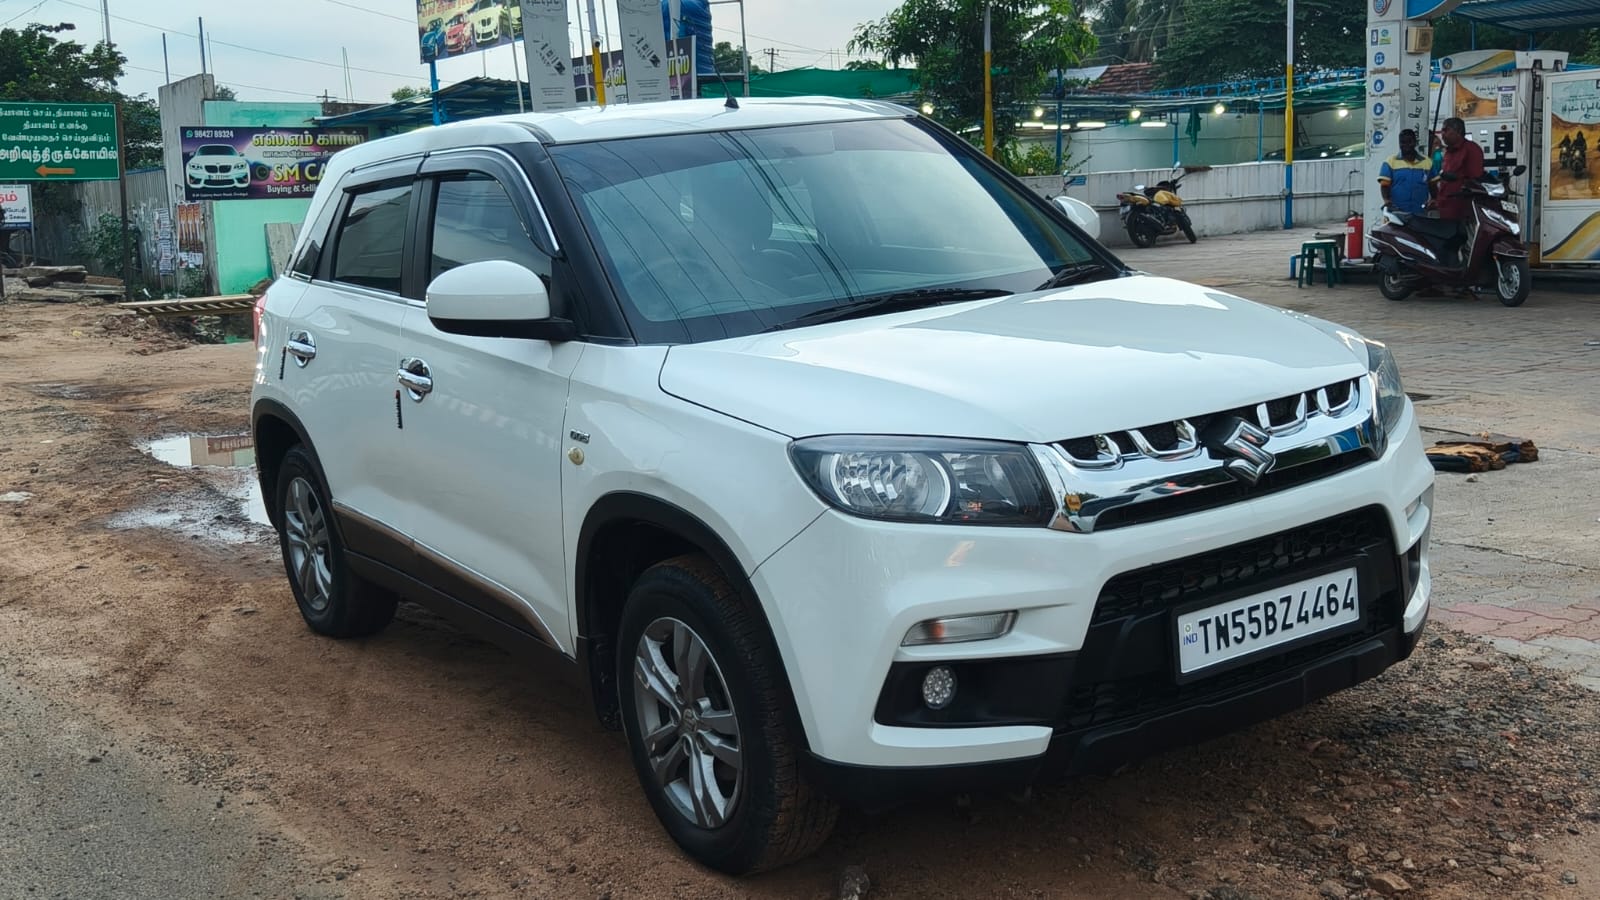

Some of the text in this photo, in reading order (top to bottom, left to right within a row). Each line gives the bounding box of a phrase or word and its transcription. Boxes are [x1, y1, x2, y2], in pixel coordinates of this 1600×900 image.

[272, 162, 301, 183] SM
[267, 184, 293, 195] Buying
[293, 185, 301, 193] &
[1198, 577, 1355, 654] TN55BZ4464
[1183, 633, 1198, 646] IND
